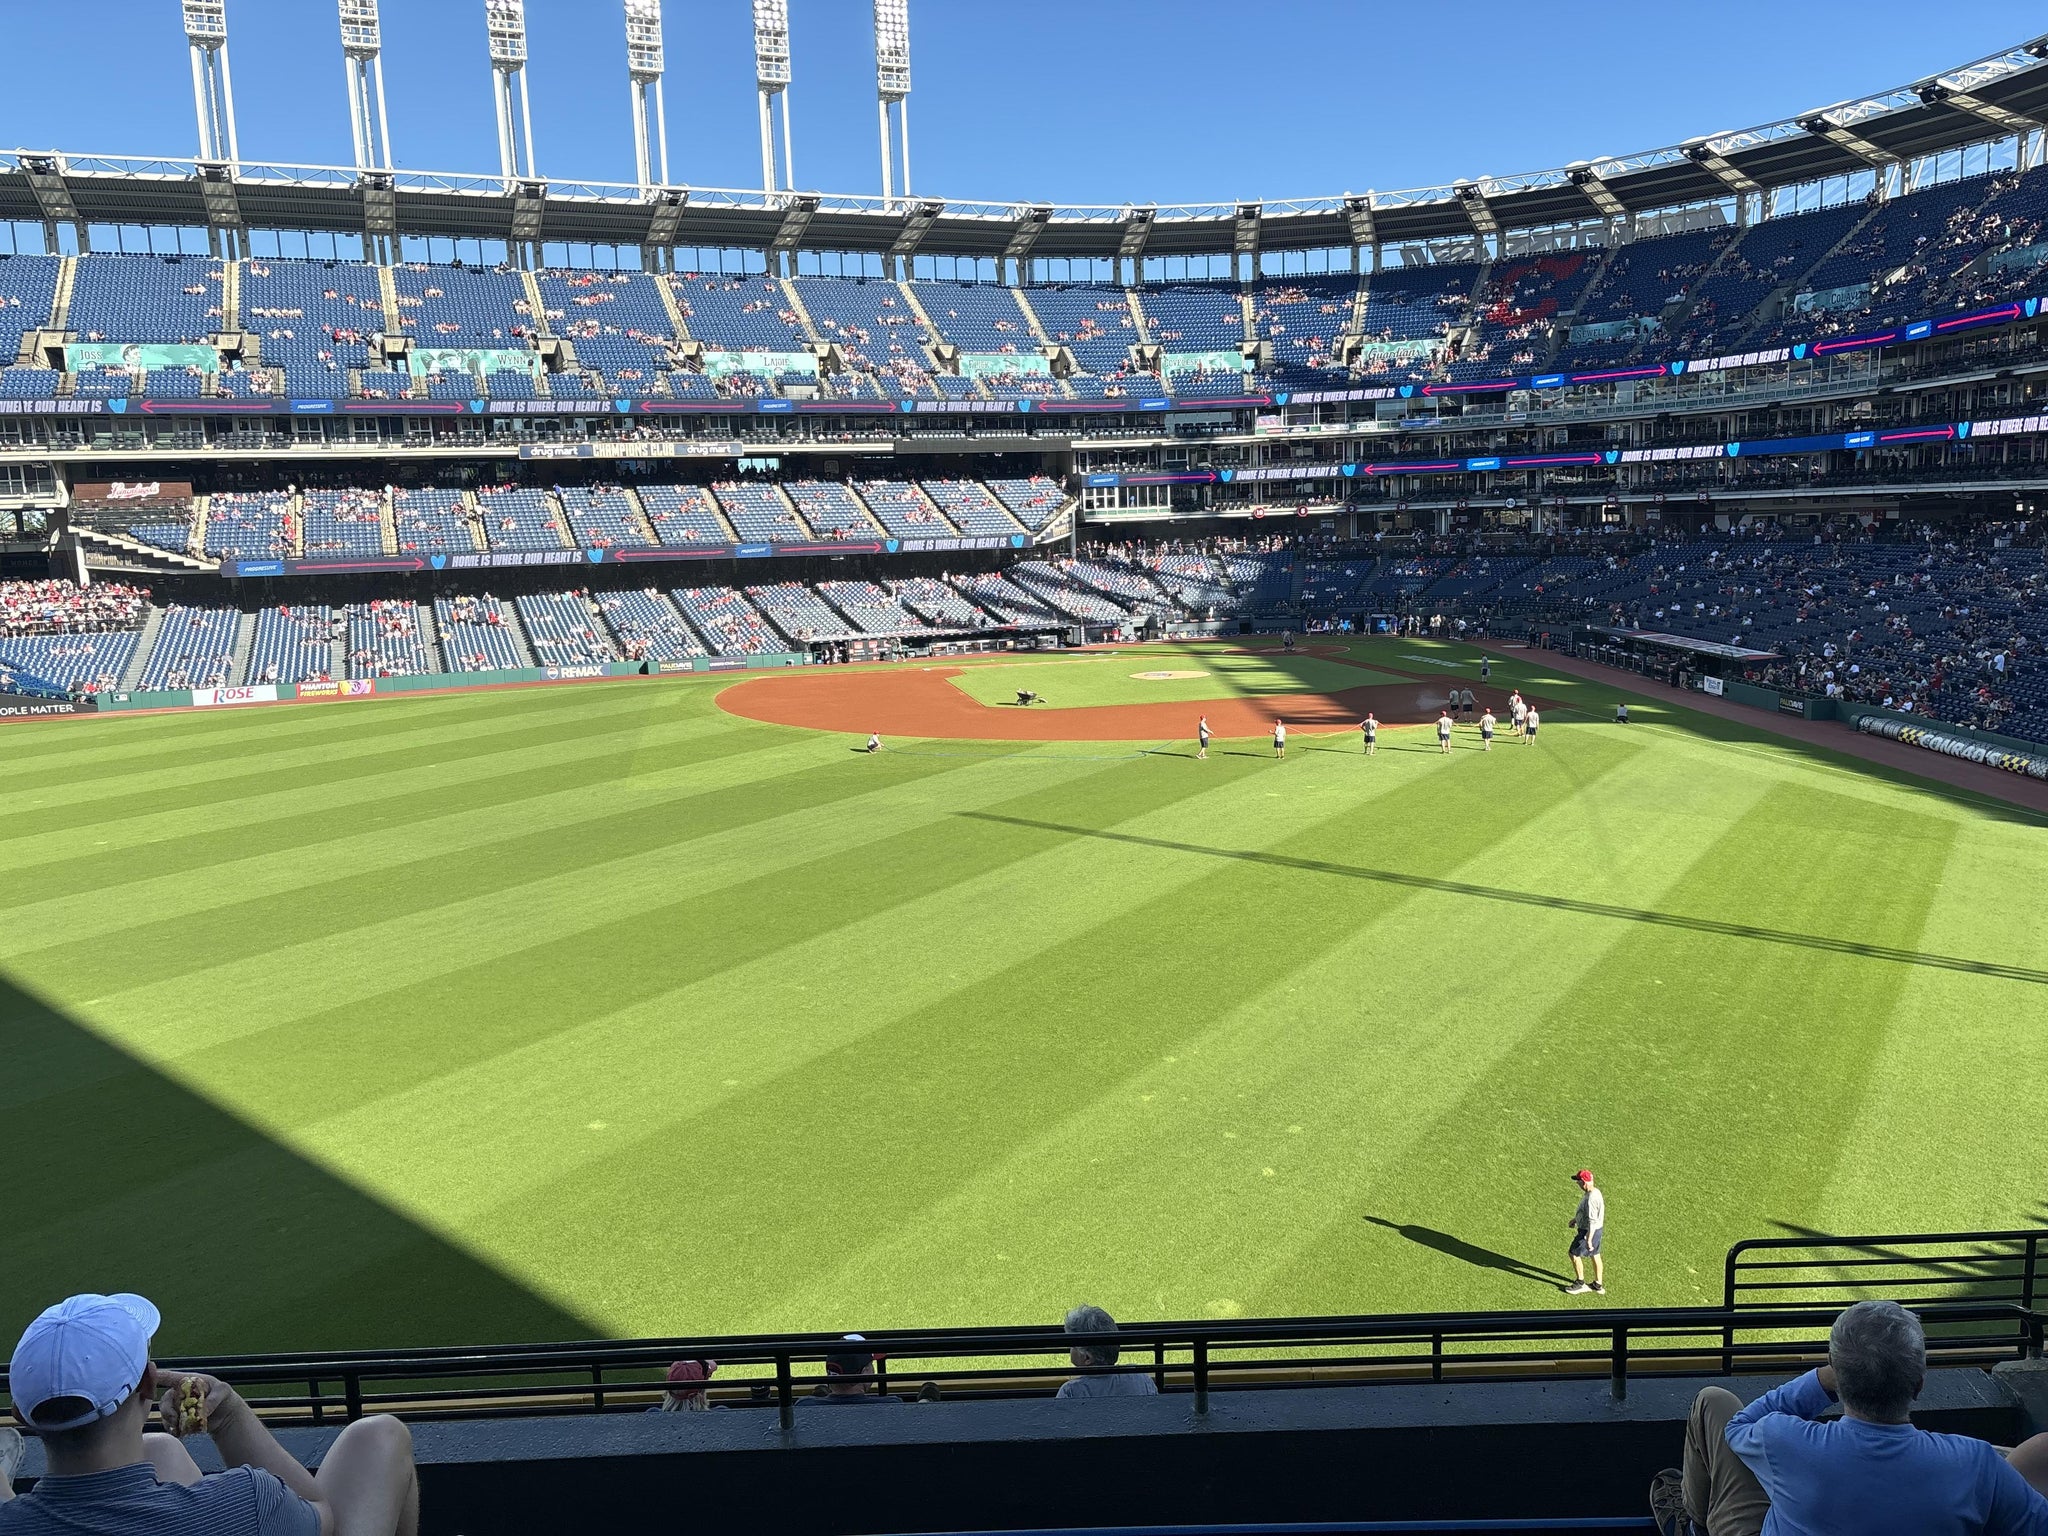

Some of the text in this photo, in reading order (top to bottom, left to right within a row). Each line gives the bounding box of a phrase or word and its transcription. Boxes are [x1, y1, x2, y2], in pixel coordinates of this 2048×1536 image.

[1576, 328, 1606, 339] SEWELL
[1687, 348, 1790, 372] HOME IS WHERE OUR HEART IS
[1292, 388, 1396, 404] HOME IS WHERE OUR HEART IS
[34, 400, 56, 412] OUR
[58, 400, 90, 412] HEART
[90, 400, 102, 412] IS
[490, 401, 611, 412] HOME IS WHERE OUR HEART IS
[916, 402, 1014, 412] HOME IS WHERE OUR HEART IS
[1971, 421, 1992, 436] HOME
[1991, 420, 2000, 434] IS
[1999, 418, 2024, 434] WHERE
[2023, 416, 2039, 432] OUR
[530, 446, 578, 458] drug mart
[592, 442, 674, 457] CHAMPIONS CLUB
[687, 444, 732, 455] drug mart
[1621, 445, 1724, 462] HOME IS WHERE OUR HEART IS
[1236, 466, 1338, 480] HOME IS WHERE OUR HEART IS
[903, 537, 1008, 550] HOME IS WHERE OUR HEART IS
[452, 551, 582, 568] HOME IS WHERE OUR HEART IS
[300, 682, 338, 691] PHANTOM
[213, 686, 254, 704] ROSE
[300, 689, 338, 698] FIREWORKS
[30, 704, 76, 714] MATTER
